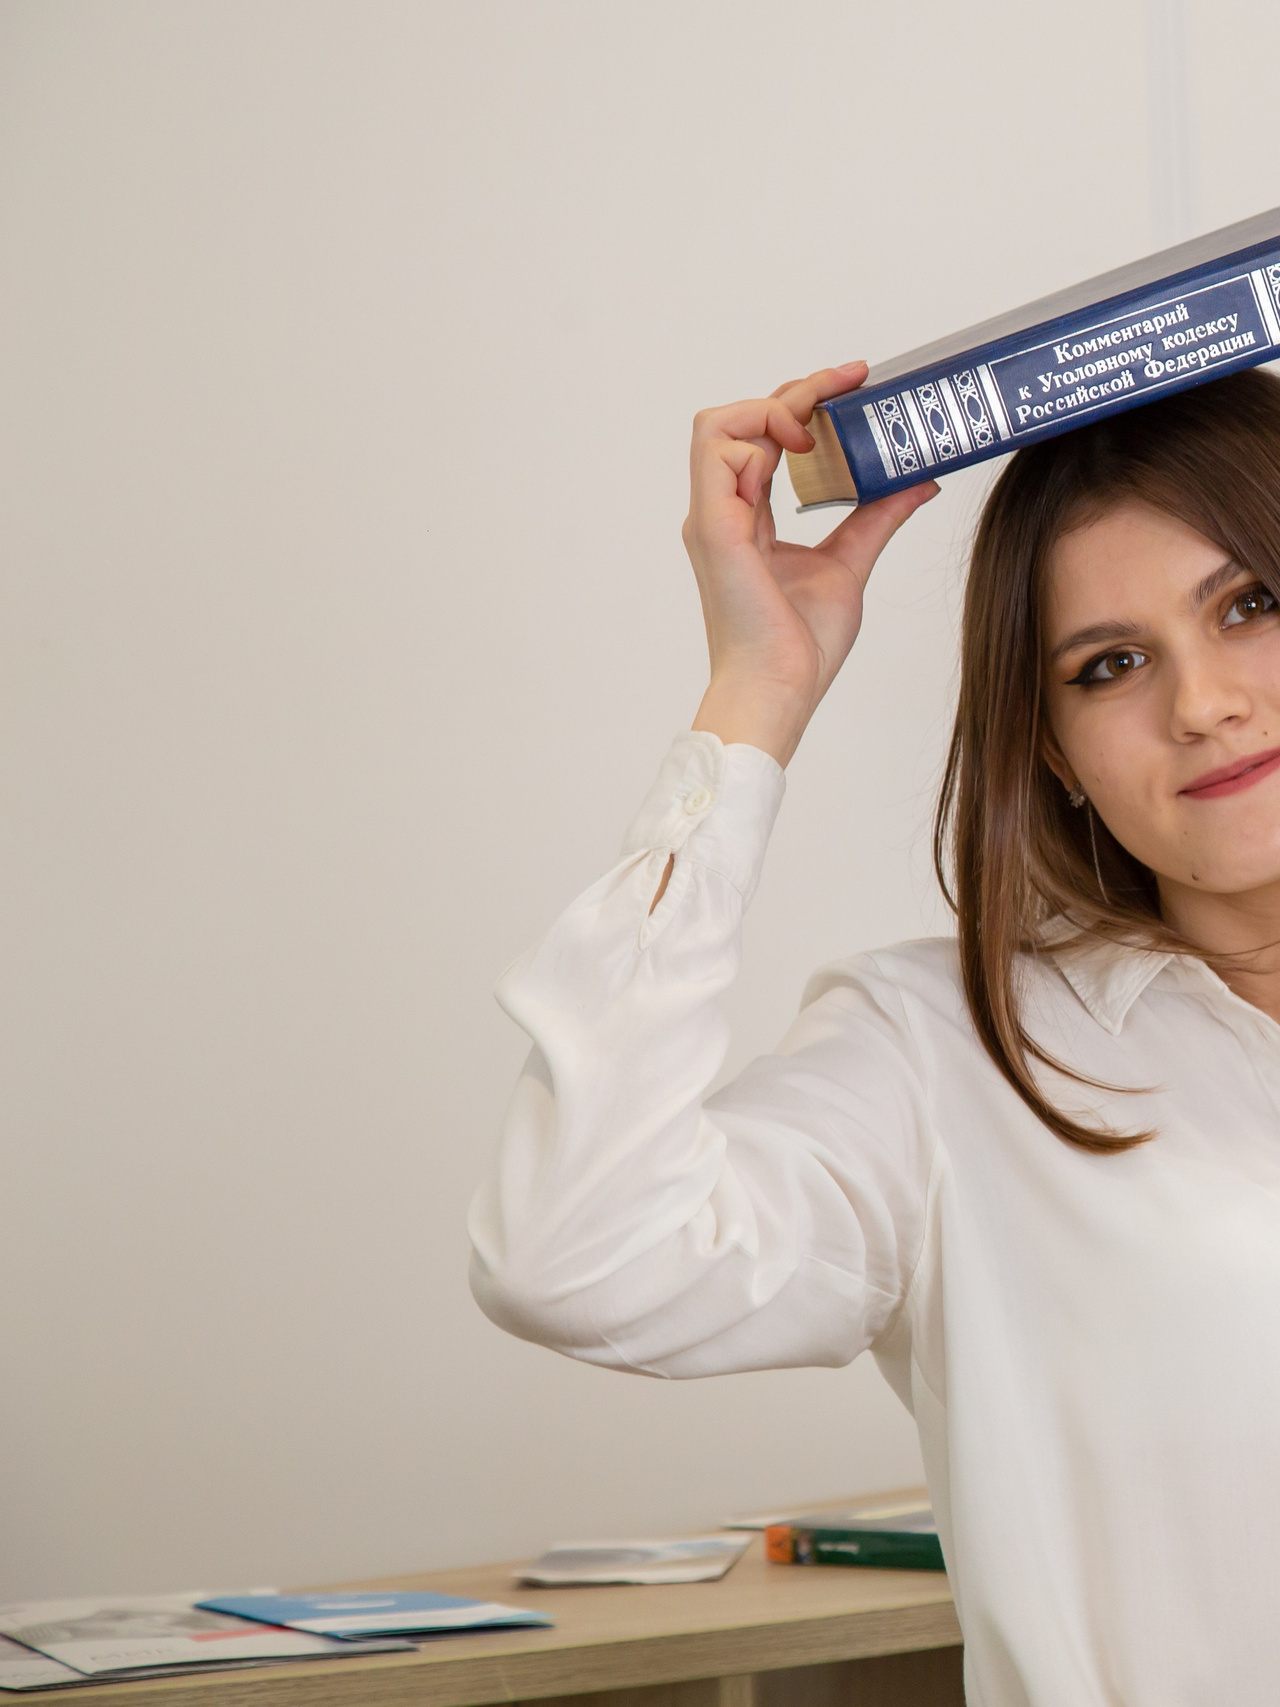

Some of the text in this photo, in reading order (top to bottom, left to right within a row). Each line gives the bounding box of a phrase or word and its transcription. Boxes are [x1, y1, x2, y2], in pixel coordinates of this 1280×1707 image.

[1018, 312, 1239, 400] к Уголовному кодексу
[1053, 303, 1190, 364] Комментарий
[1015, 331, 1256, 425] Российской Федерации
